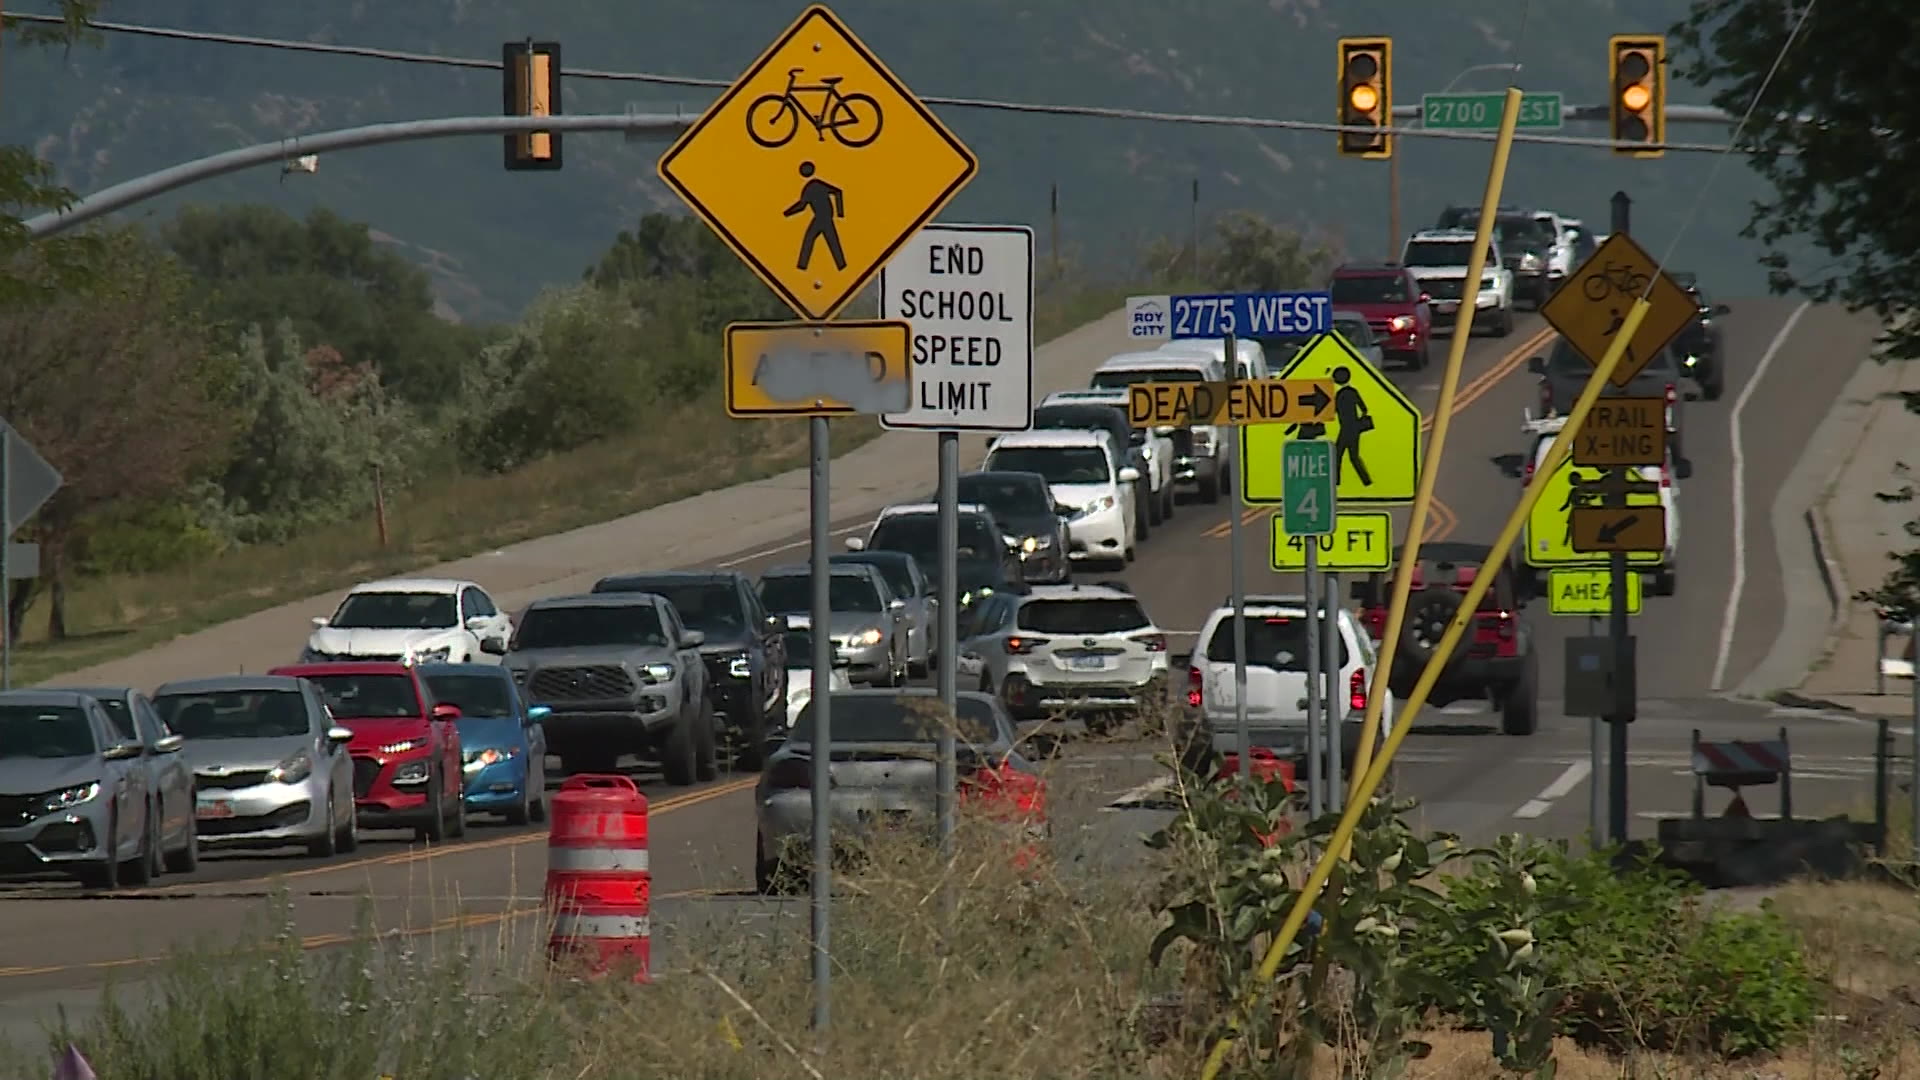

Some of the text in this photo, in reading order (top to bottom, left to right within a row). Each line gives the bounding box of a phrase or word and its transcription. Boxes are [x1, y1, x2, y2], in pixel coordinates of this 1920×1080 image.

[1428, 101, 1557, 122] 2700 EST
[929, 245, 984, 275] END
[900, 289, 1013, 322] SCHOOL
[1133, 312, 1163, 323] ROY
[1174, 297, 1328, 335] 2775 WEST
[1132, 325, 1165, 337] CITY
[912, 336, 1001, 366] SPEED
[921, 382, 991, 411] LIMIT
[1131, 384, 1289, 423] DEAD END
[1583, 407, 1653, 429] TRAIL
[1585, 435, 1653, 456] X-ING
[1287, 453, 1328, 479] MILE
[1296, 488, 1319, 522] 4
[1286, 530, 1375, 552] 40 FT
[1561, 583, 1627, 600] AHEA
